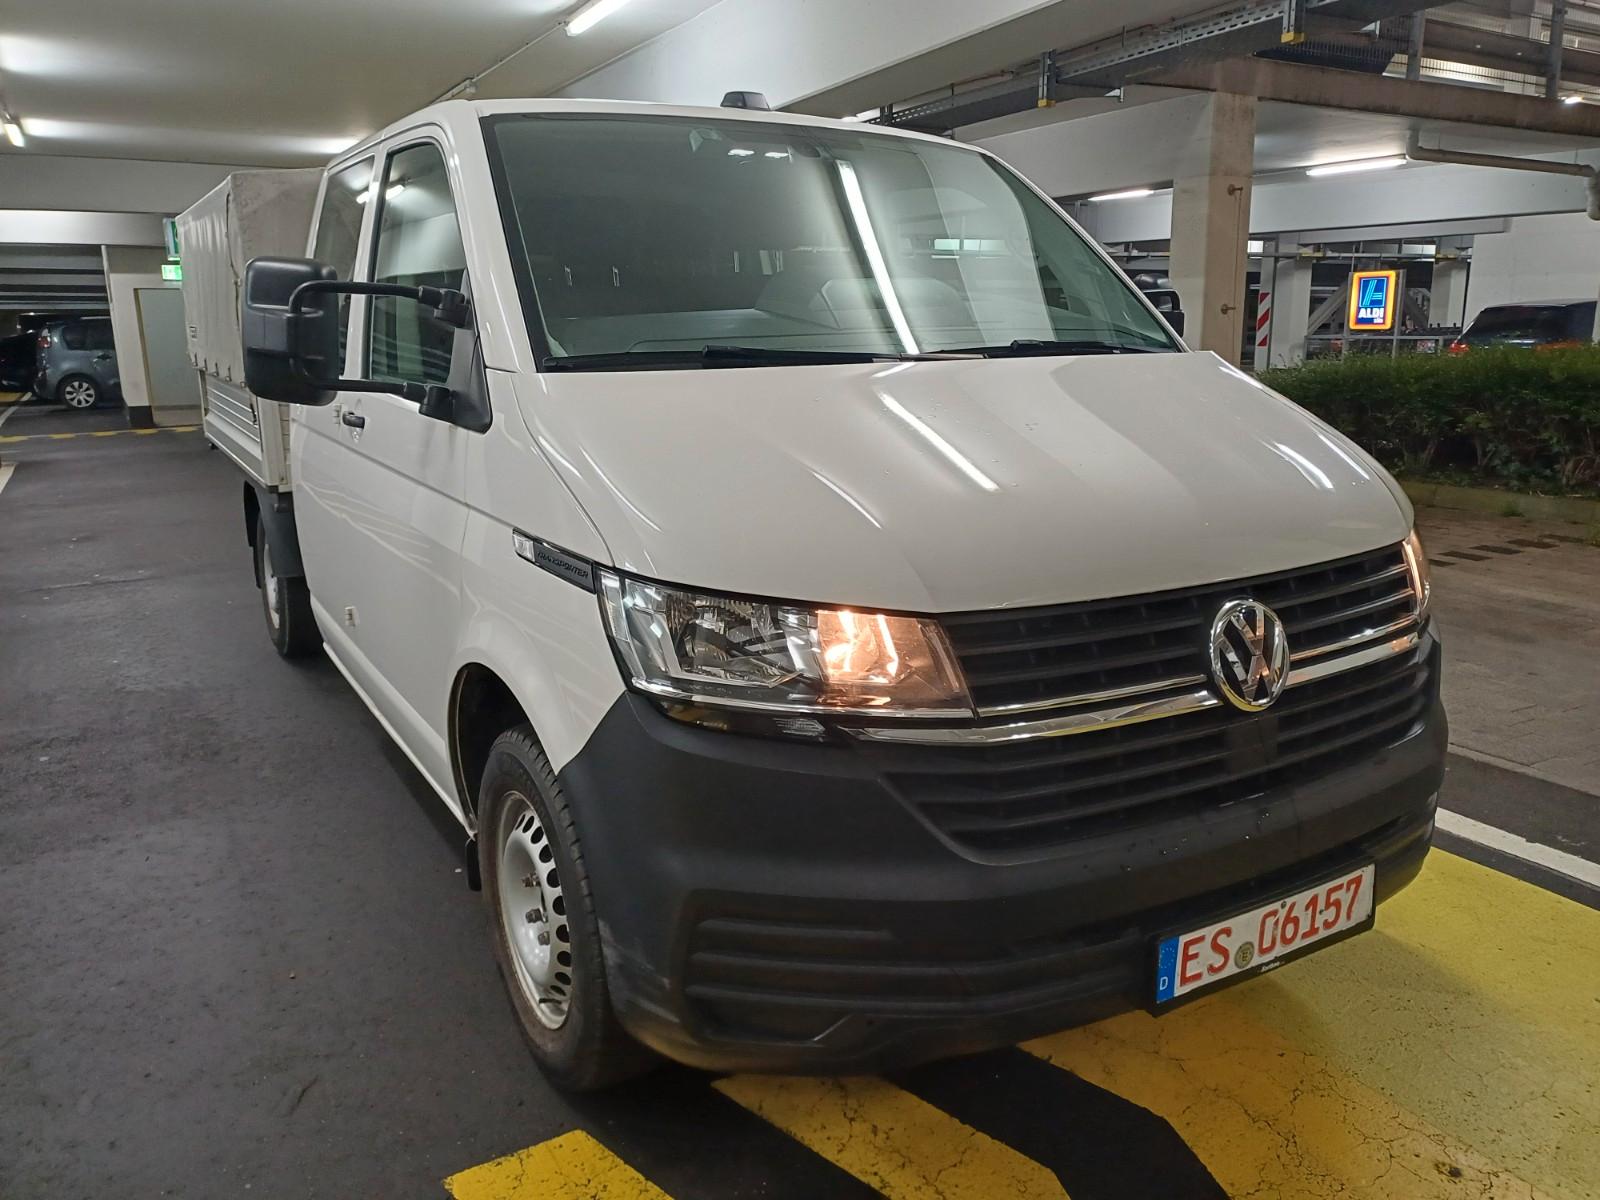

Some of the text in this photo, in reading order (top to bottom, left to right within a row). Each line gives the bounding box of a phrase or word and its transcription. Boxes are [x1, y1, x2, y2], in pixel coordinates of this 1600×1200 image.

[1358, 307, 1385, 319] ALDI
[537, 551, 589, 578] TRANSPORTER
[1179, 873, 1363, 987] ES 06157
[1159, 976, 1169, 991] D
